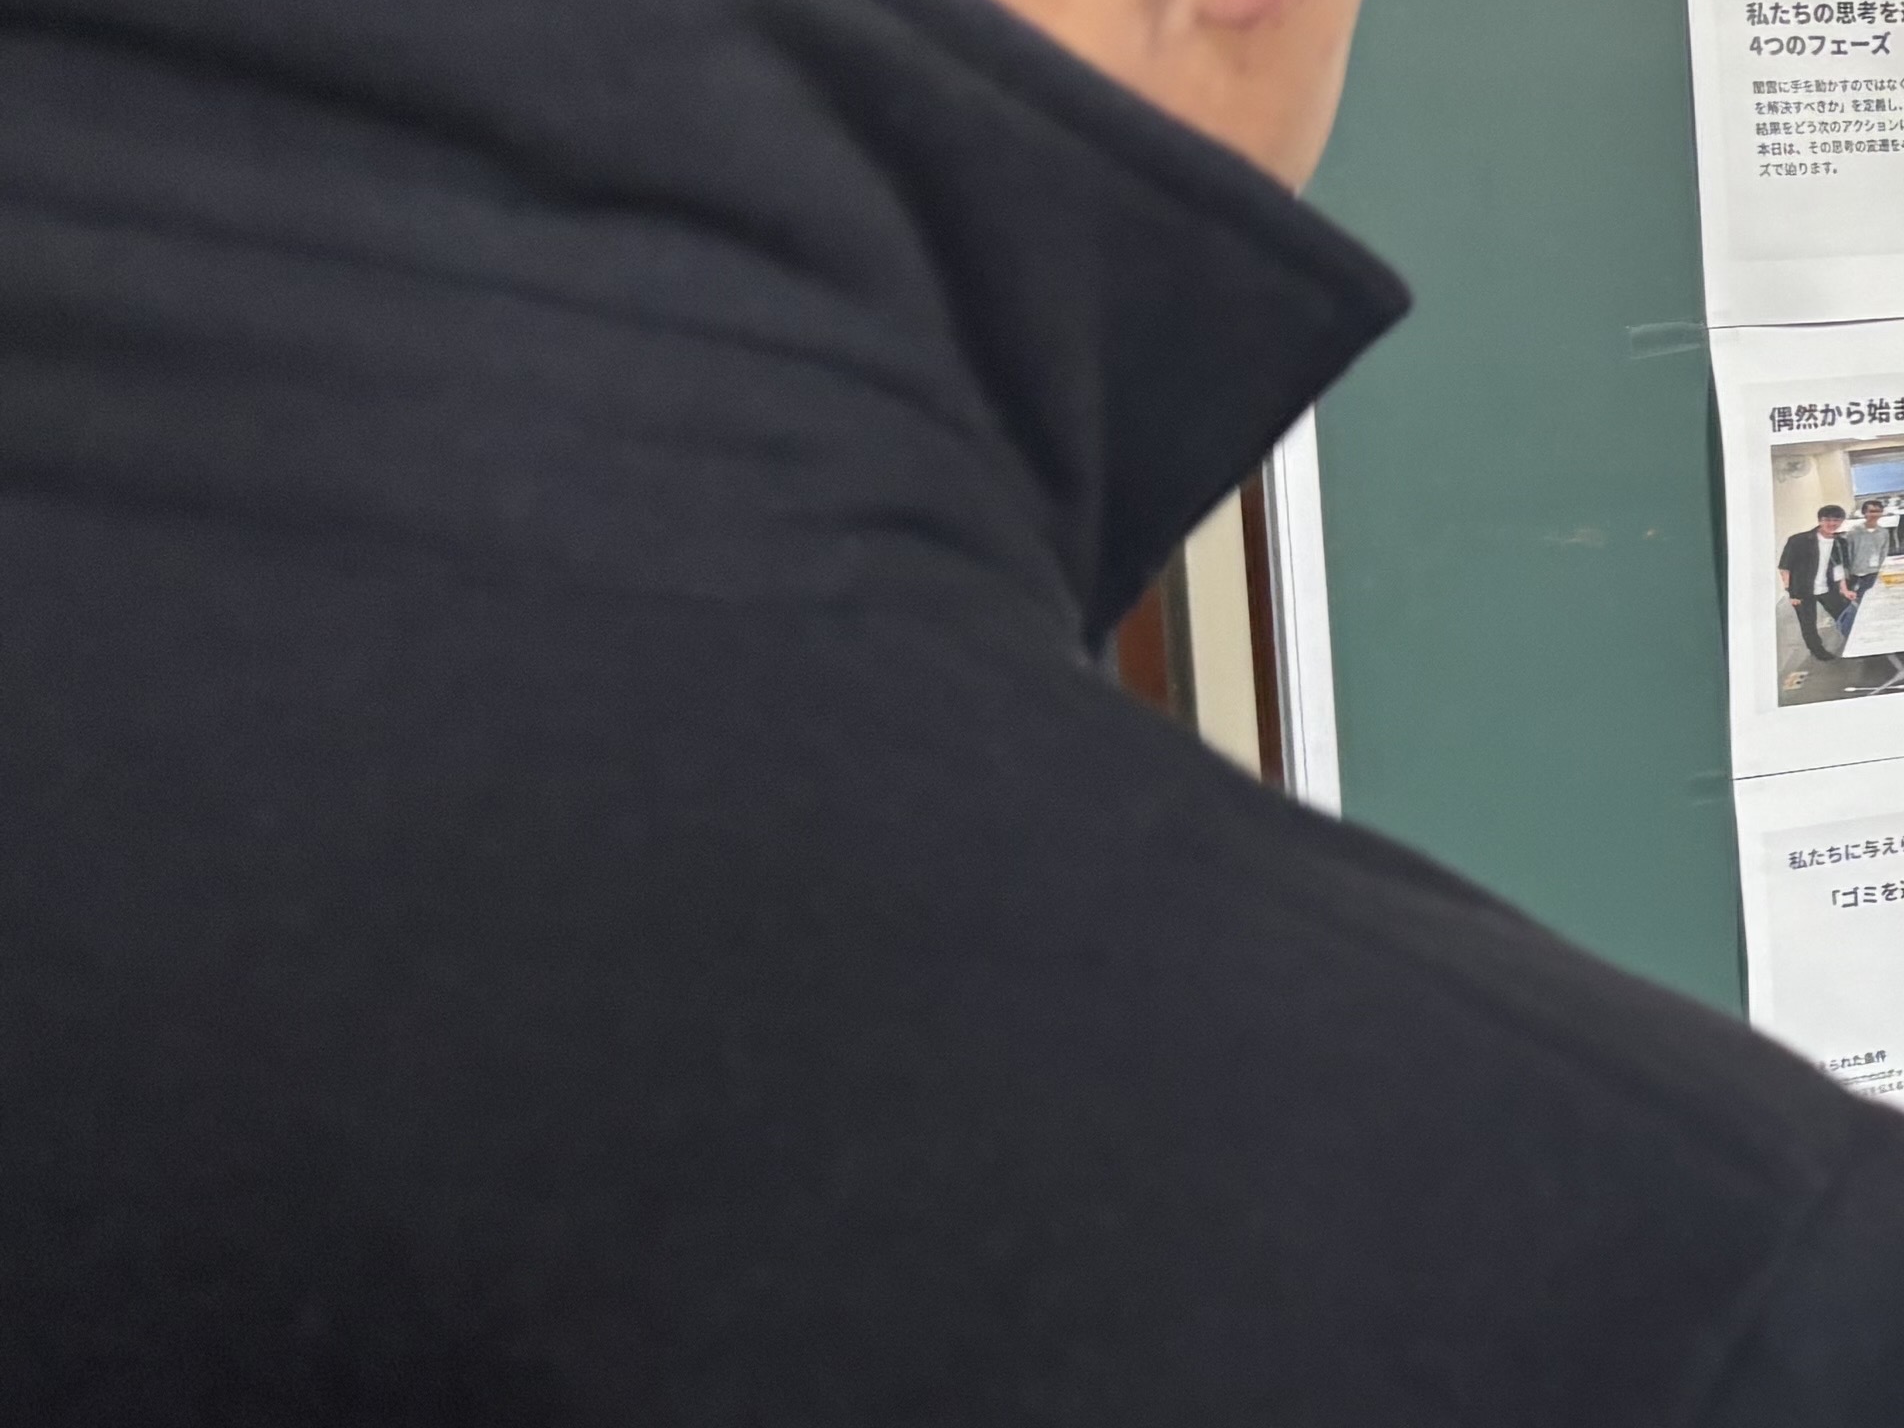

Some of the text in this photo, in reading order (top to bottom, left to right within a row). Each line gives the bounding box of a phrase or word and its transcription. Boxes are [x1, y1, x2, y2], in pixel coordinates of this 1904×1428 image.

[1750, 31, 1891, 55] 4つのフェーズ
